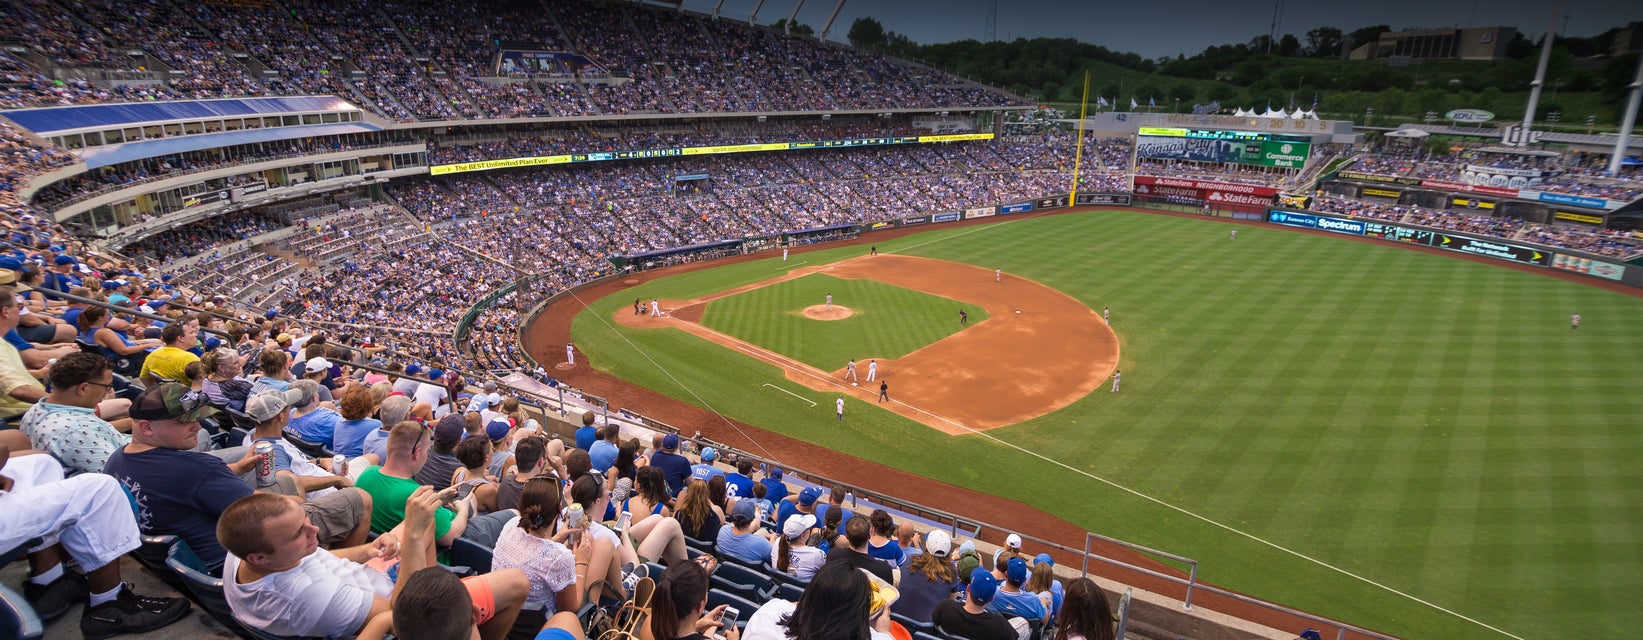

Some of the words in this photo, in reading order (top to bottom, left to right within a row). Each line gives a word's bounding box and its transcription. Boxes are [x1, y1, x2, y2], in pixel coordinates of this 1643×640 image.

[1115, 113, 1126, 121] 42
[1270, 120, 1283, 129] 20
[1295, 120, 1305, 128] 10
[1320, 121, 1327, 129] 5
[1500, 126, 1544, 147] Lite
[1137, 143, 1184, 157] Kansas
[1185, 138, 1211, 153] City
[1266, 152, 1304, 161] Commerce
[487, 159, 518, 168] Unlimited
[1196, 182, 1254, 193] NEIGHBORHOOD
[1318, 218, 1361, 232] Spectrum
[696, 468, 710, 476] YOST
